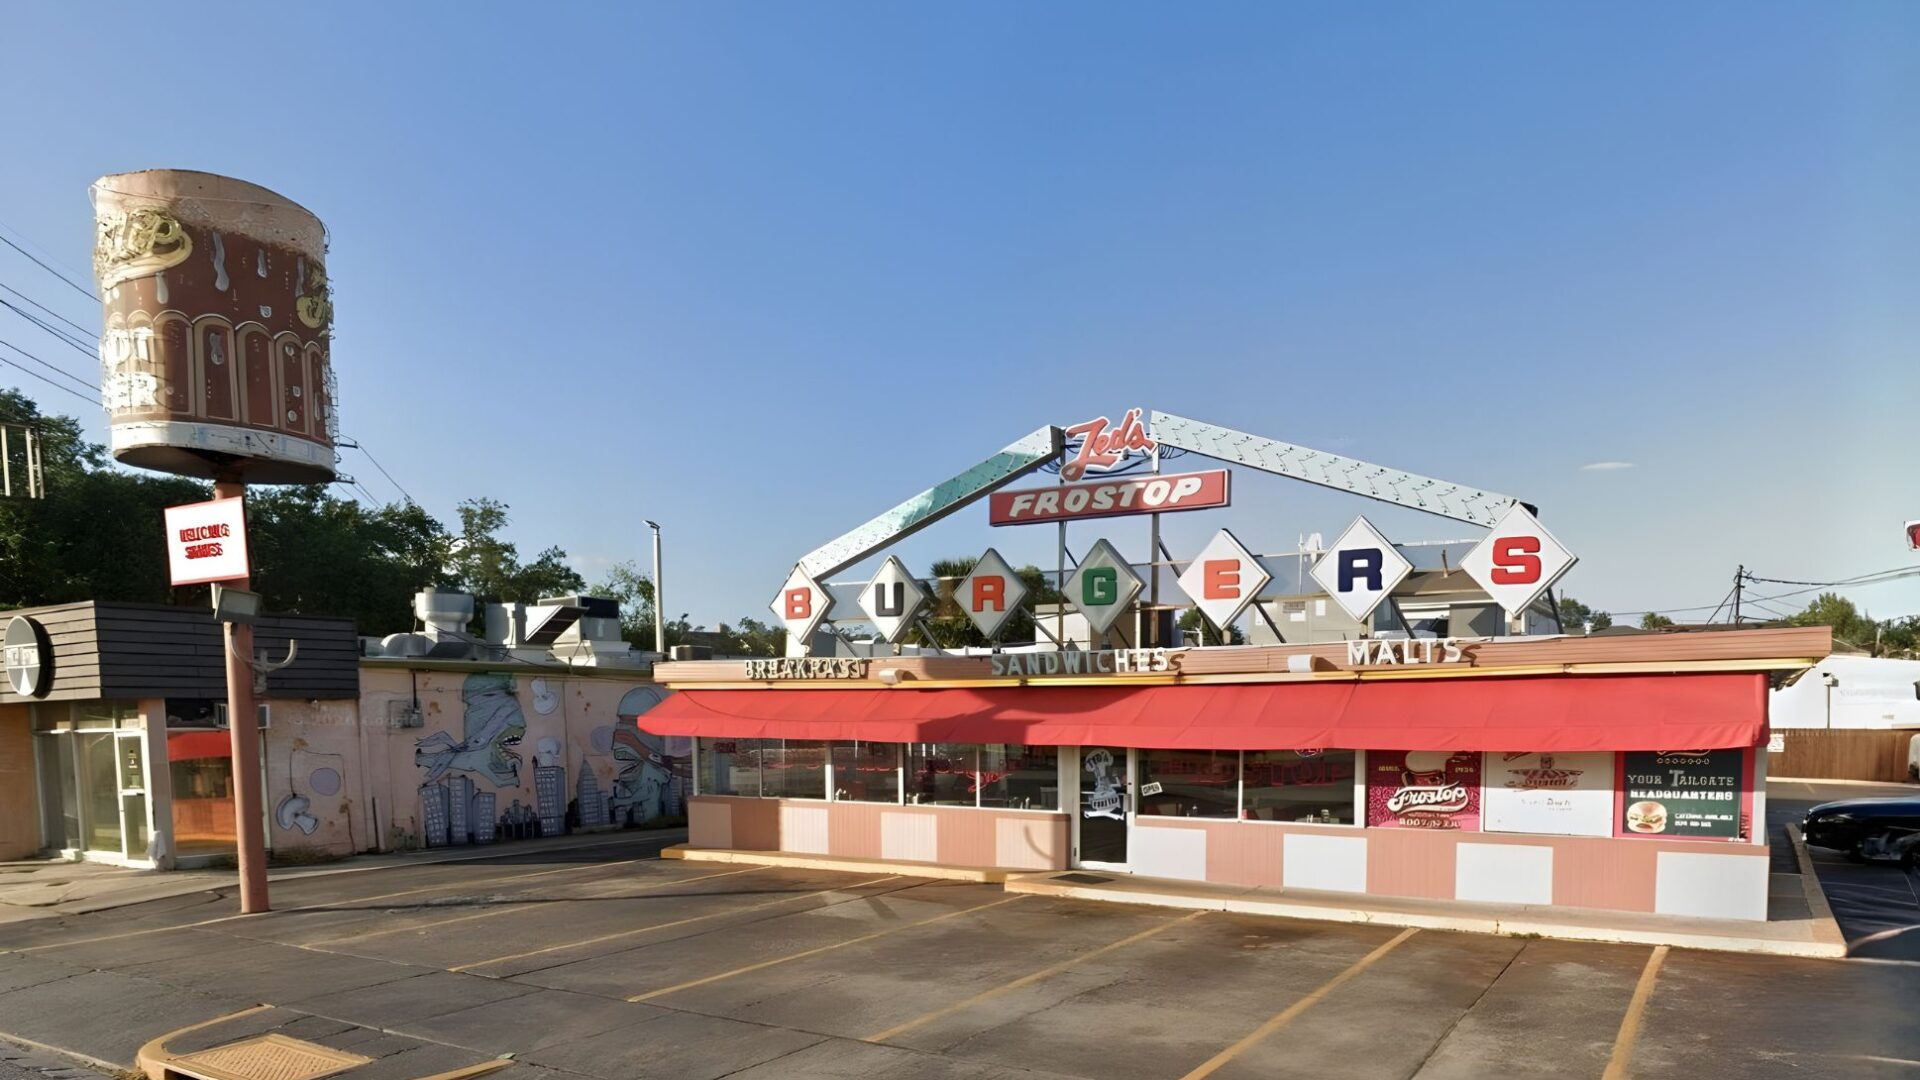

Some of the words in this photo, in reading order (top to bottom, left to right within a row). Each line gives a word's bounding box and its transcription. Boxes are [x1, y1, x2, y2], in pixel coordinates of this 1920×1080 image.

[1061, 407, 1158, 482] Ted's
[1009, 477, 1202, 518] FROSTOP
[991, 648, 1169, 675] SANDWICHES
[1347, 637, 1461, 665] MALTS
[1627, 775, 1662, 785] YOUR
[1387, 783, 1468, 813] Frostop
